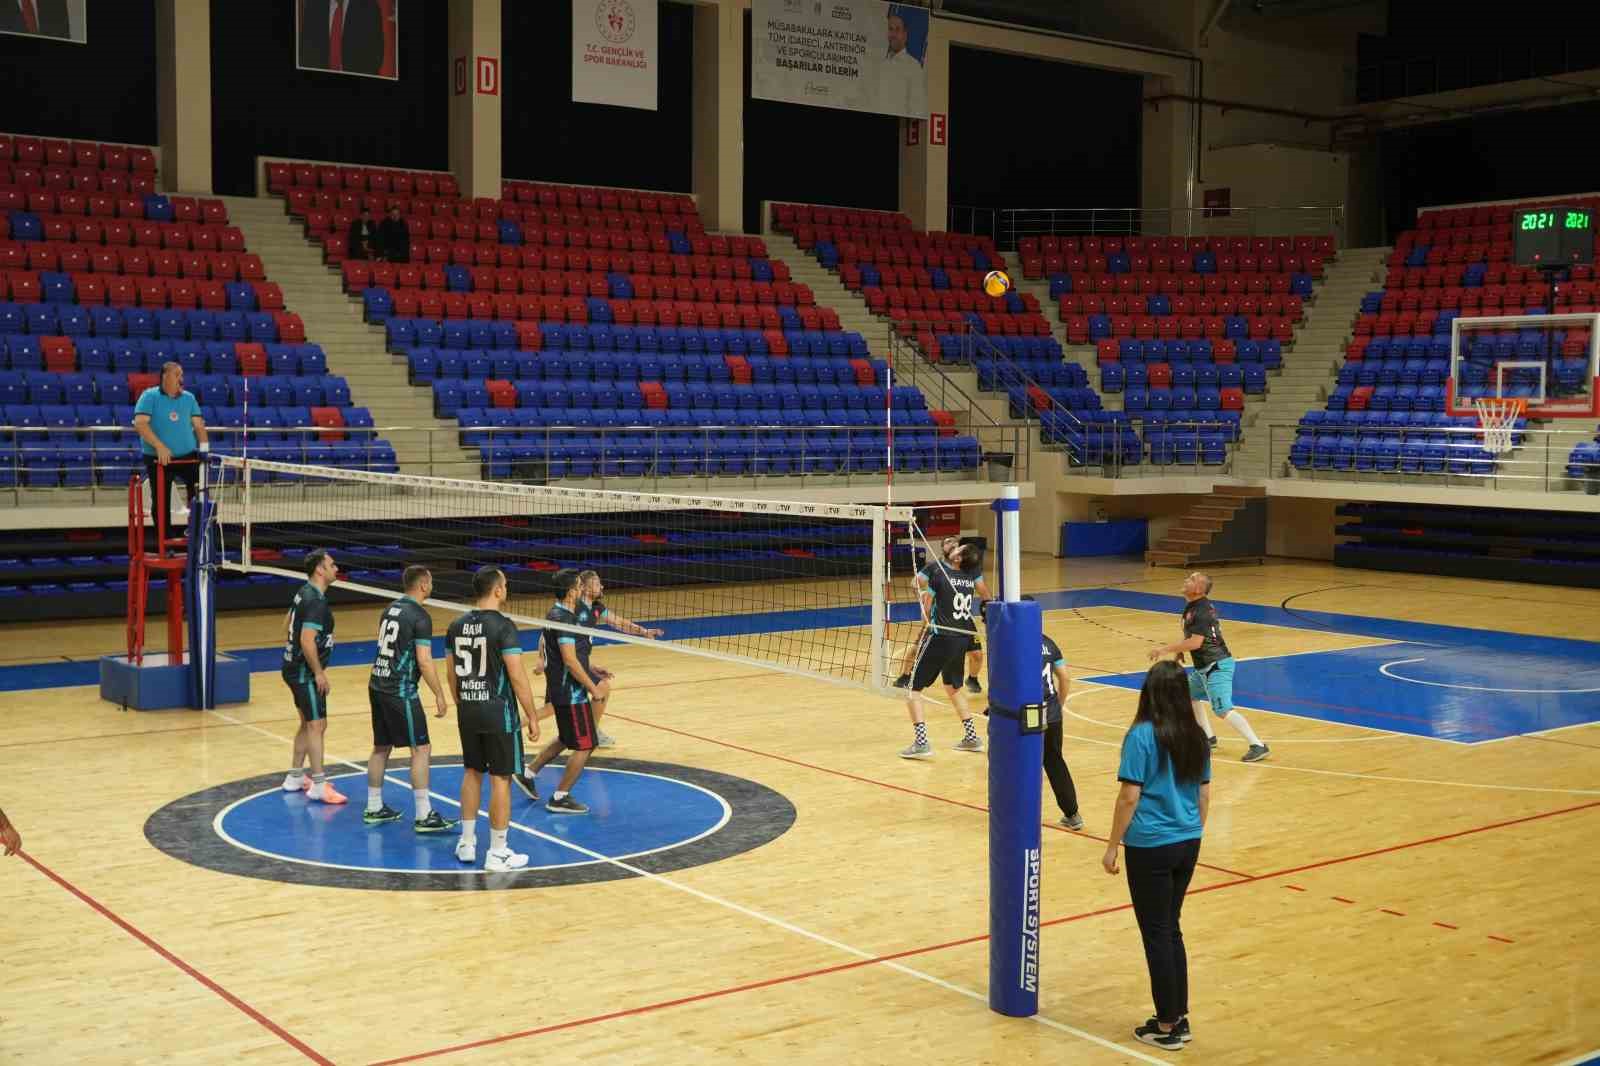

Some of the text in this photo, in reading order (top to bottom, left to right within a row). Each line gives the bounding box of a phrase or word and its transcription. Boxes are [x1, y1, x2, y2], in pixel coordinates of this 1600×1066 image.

[768, 31, 786, 44] TÜM
[834, 30, 867, 43] KATILAN
[584, 54, 604, 65] SPOR
[481, 61, 494, 91] D
[775, 58, 859, 79] BAŞARILAR DİLERİM
[933, 116, 943, 143] E
[855, 508, 867, 516] TVF
[455, 636, 487, 677] 57
